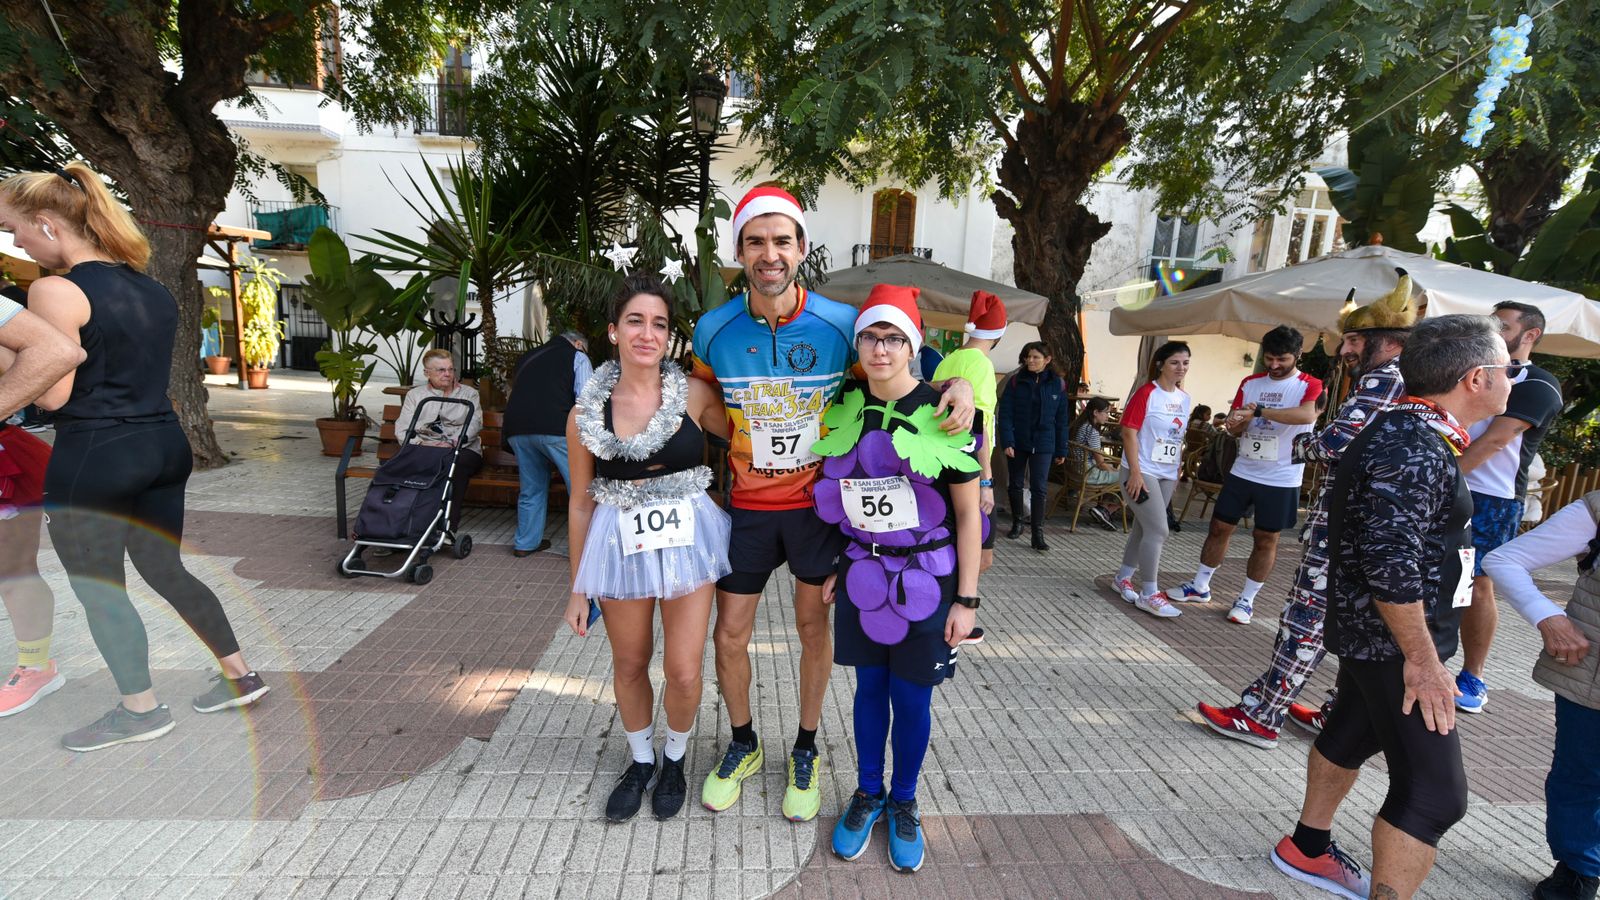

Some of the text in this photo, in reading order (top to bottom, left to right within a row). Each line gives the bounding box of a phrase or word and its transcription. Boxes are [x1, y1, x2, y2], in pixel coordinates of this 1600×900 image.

[751, 383, 791, 400] TRAIL
[744, 403, 783, 416] TEAM
[783, 415, 814, 428] SILVESTRE
[771, 433, 801, 456] 57
[1163, 445, 1177, 456] 10
[1253, 441, 1261, 453] 9
[861, 494, 894, 517] 56
[633, 508, 682, 535] 104
[1232, 718, 1250, 731] N
